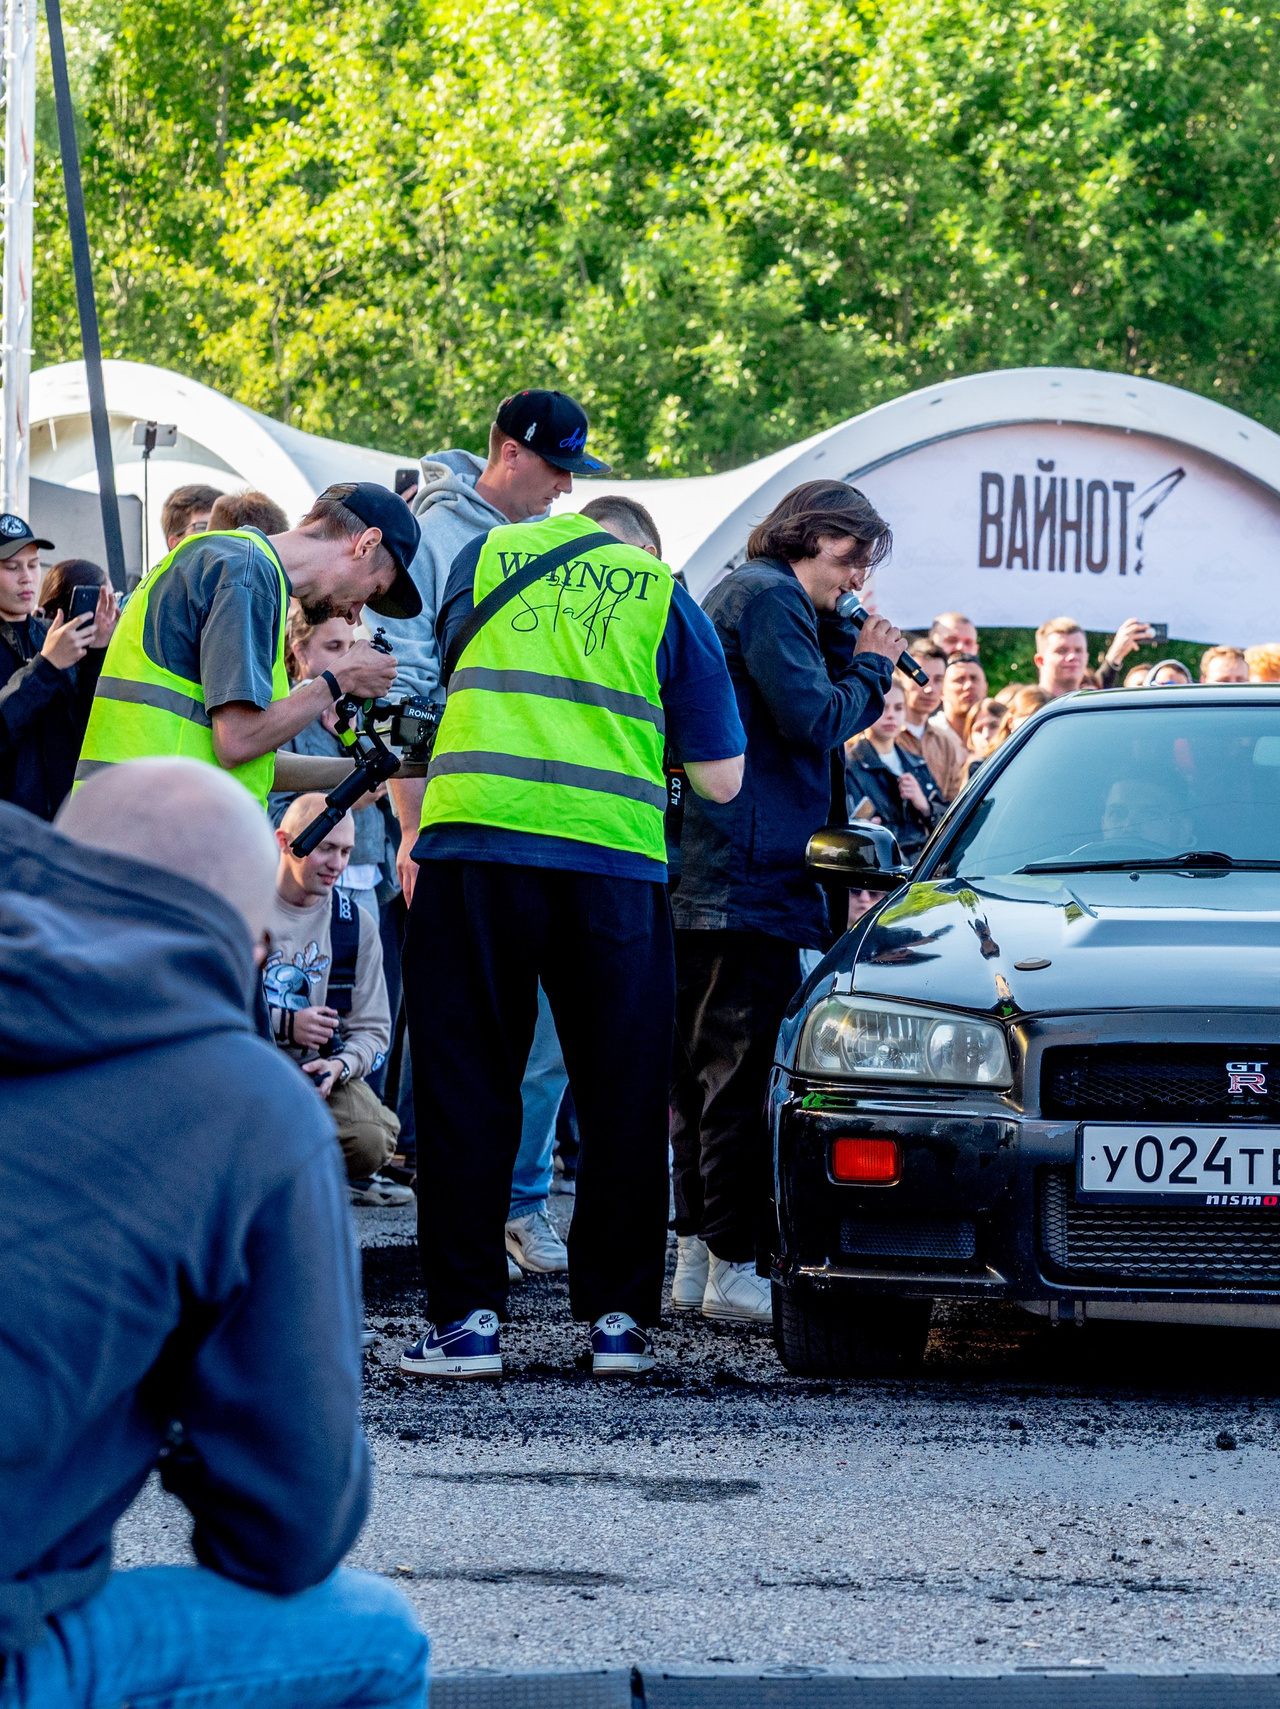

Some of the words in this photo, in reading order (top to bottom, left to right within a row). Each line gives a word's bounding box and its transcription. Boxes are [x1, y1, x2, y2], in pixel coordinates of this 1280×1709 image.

[409, 708, 436, 721] RONIN
[1226, 1062, 1268, 1072] GT
[1228, 1072, 1268, 1094] R
[1206, 1195, 1278, 1206] nismo
